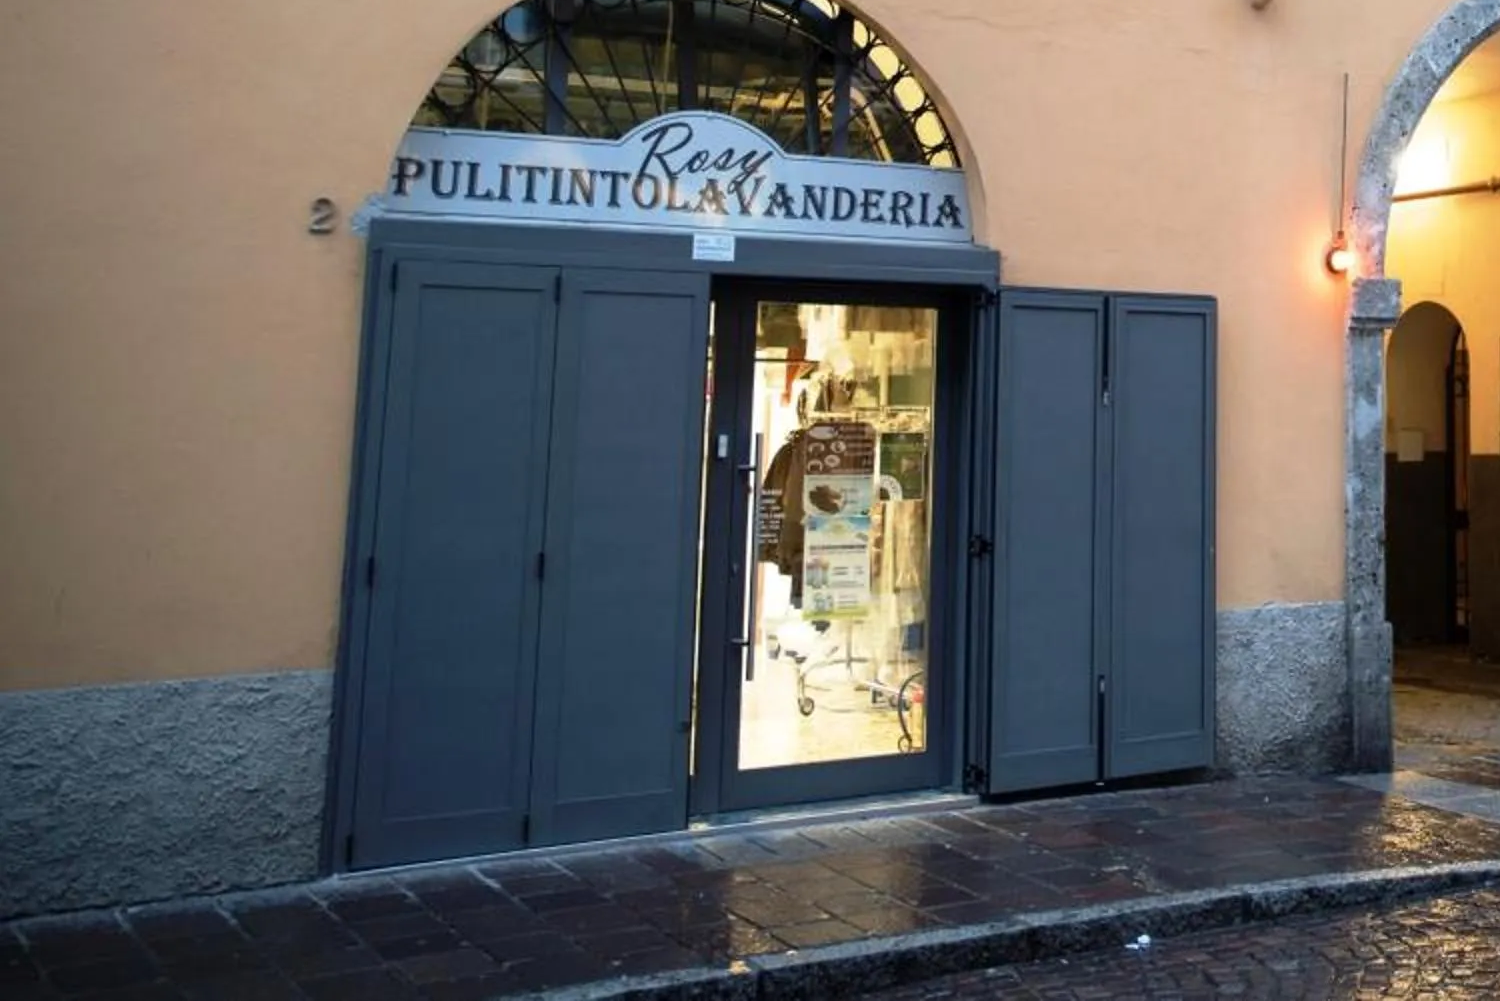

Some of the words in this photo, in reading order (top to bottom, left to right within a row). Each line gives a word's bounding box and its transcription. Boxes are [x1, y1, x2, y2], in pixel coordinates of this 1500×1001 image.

[391, 156, 965, 230] PULITINTOLAVANDERIA
[641, 122, 774, 194] Rosy
[308, 197, 338, 235] 2
